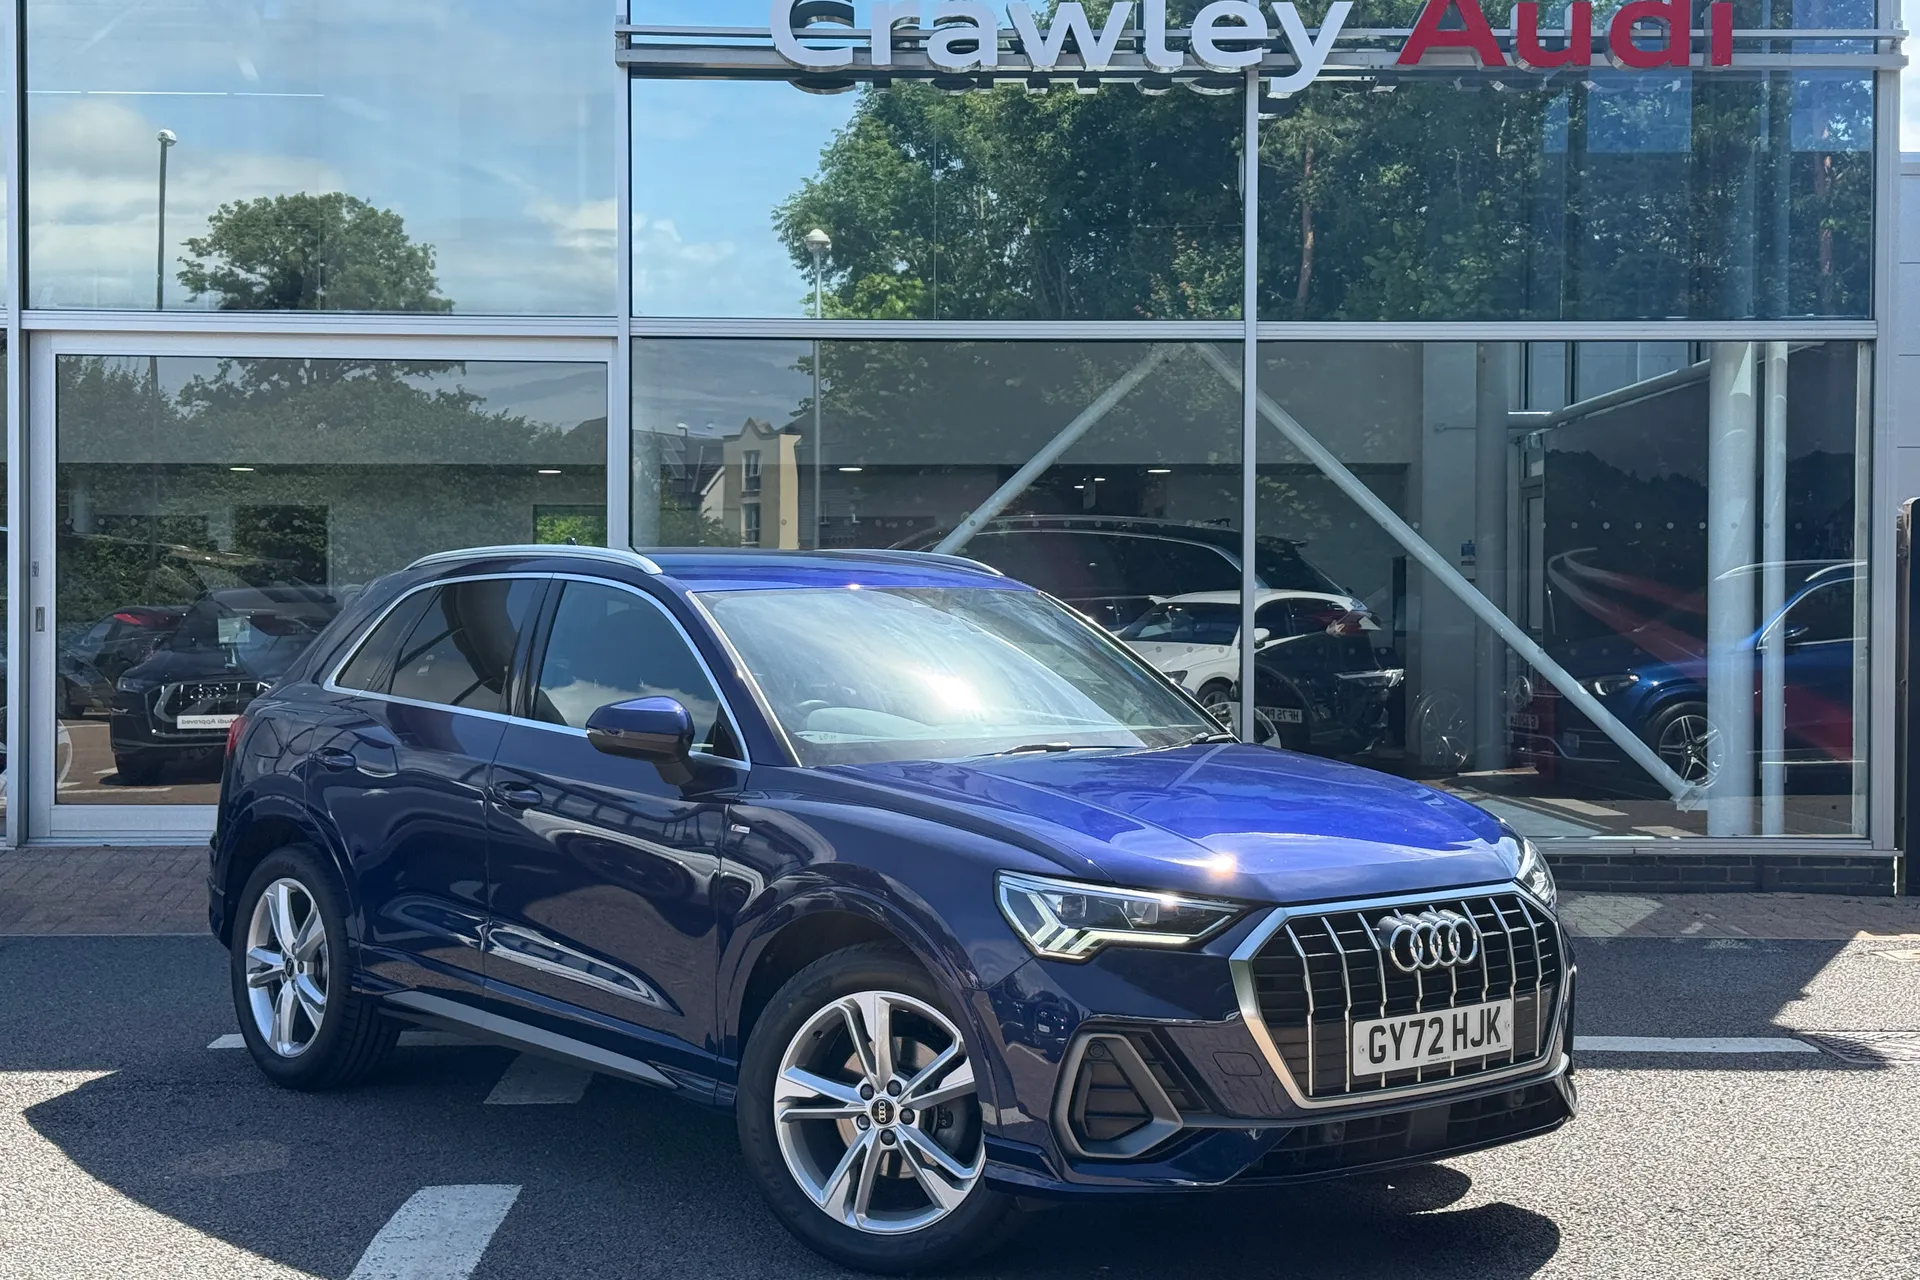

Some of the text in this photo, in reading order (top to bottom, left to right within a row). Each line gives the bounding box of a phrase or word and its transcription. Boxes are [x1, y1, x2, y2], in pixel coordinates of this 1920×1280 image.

[770, 0, 1733, 97] Crawley Audi
[1368, 1005, 1501, 1064] GY72 HJK
